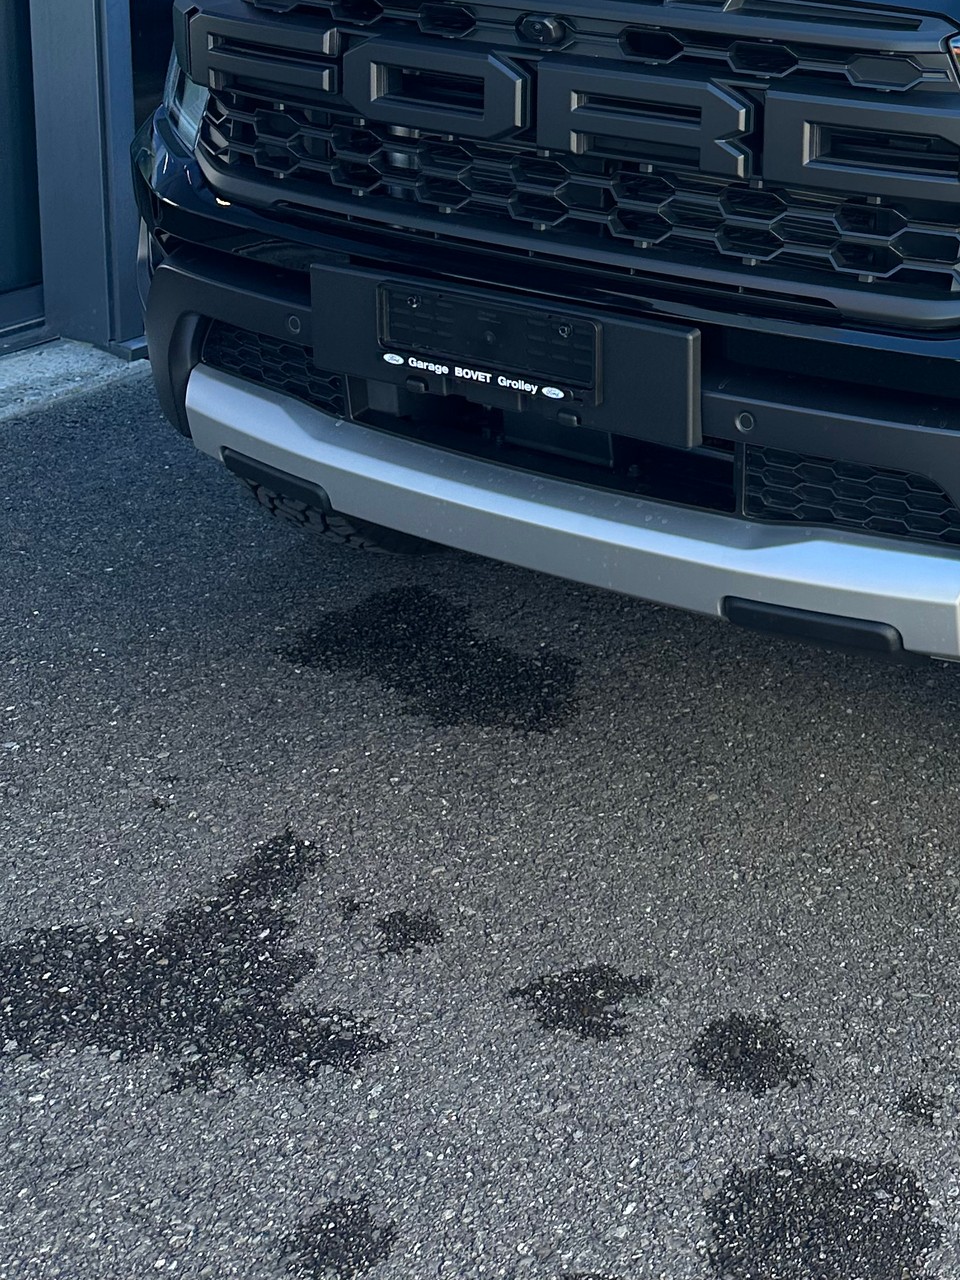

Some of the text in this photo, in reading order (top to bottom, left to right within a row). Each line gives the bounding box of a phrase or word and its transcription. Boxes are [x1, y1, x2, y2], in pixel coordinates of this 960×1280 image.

[407, 357, 449, 375] Garage
[454, 367, 492, 383] BOVET
[497, 376, 539, 394] Grolley
